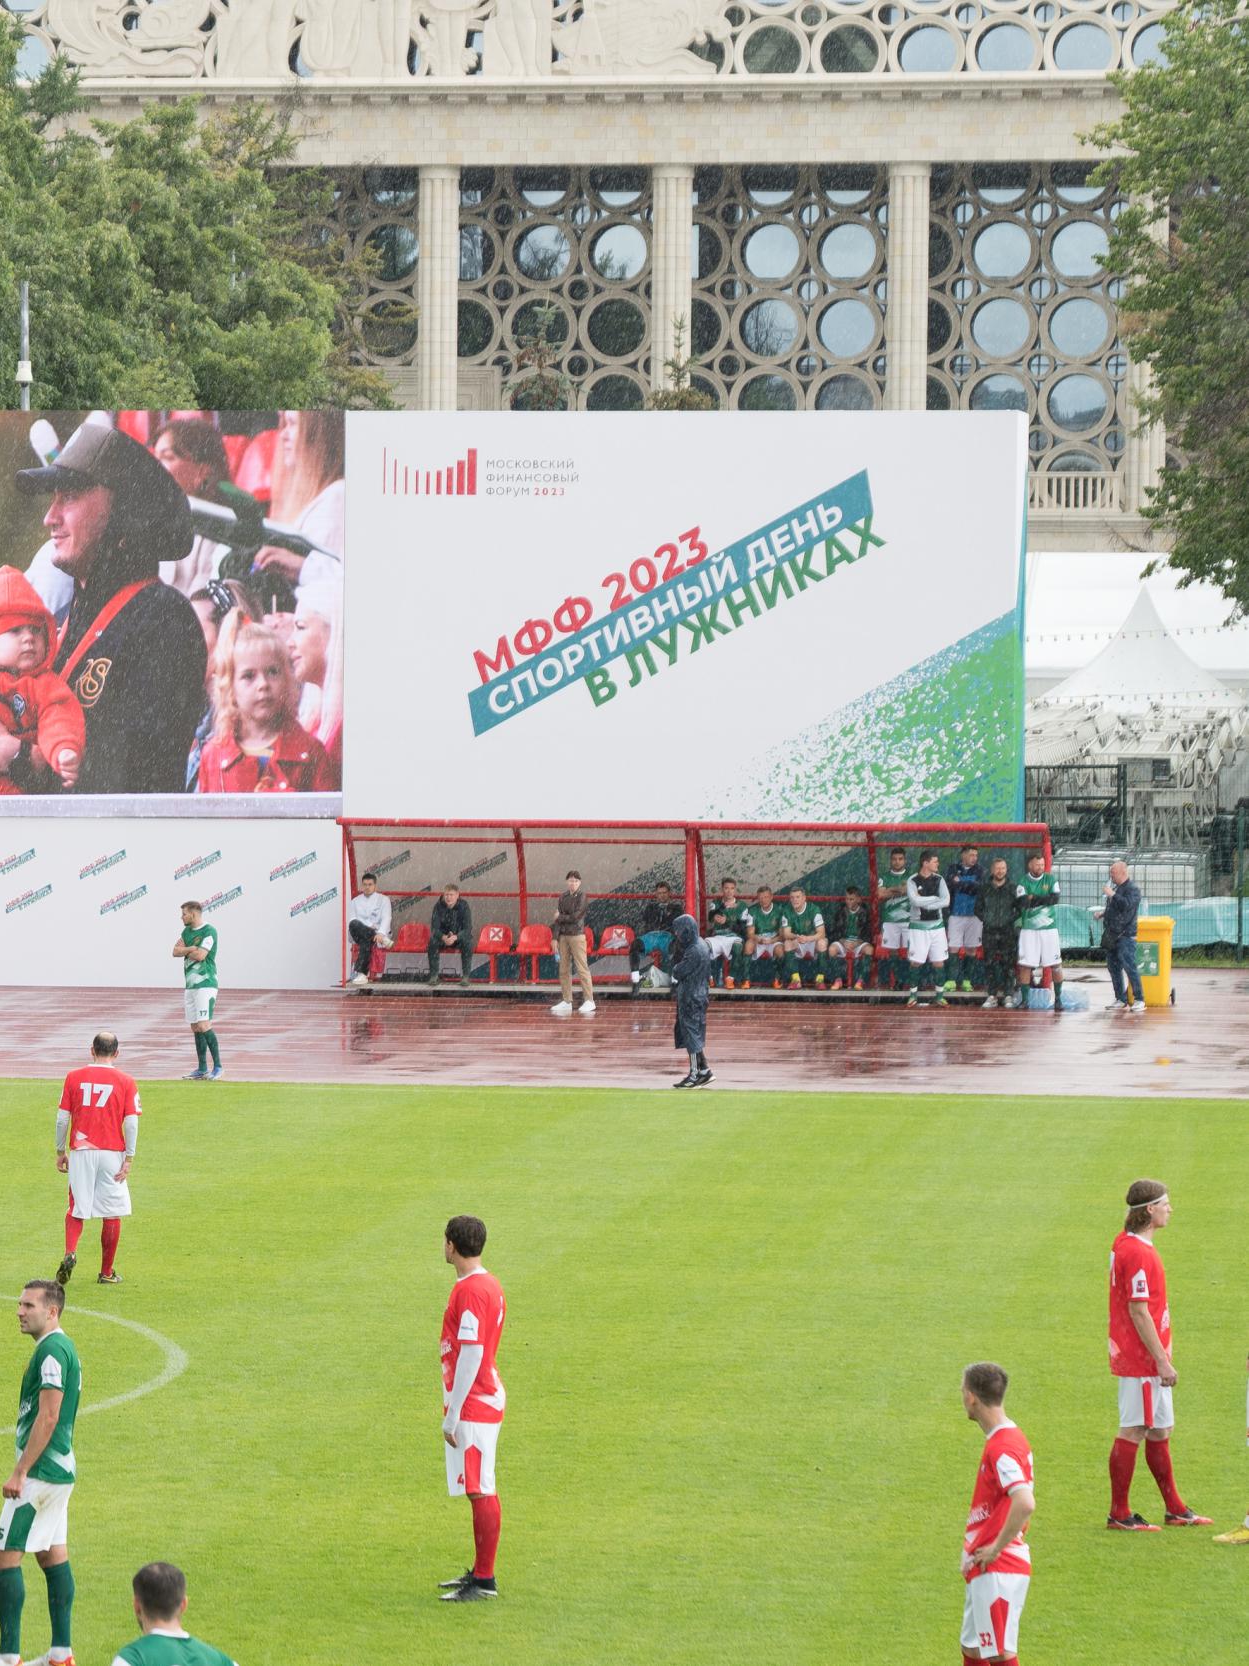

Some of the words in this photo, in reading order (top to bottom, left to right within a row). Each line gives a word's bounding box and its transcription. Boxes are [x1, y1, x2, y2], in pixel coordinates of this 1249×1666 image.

[486, 458, 575, 469] МОСКОВСКИЙ
[486, 472, 580, 483] ФИНАНСОВЫЙ
[485, 486, 530, 498] ФОРУМ
[534, 487, 566, 496] 2023
[472, 595, 594, 685] МФФ
[601, 525, 709, 612] 2023
[487, 551, 739, 715] СПОРТИВНЫЙ
[745, 501, 843, 578] ДЕНЬ
[583, 667, 618, 708] В
[623, 513, 888, 689] ЛУЖНИКАХ
[80, 1082, 114, 1107] 17
